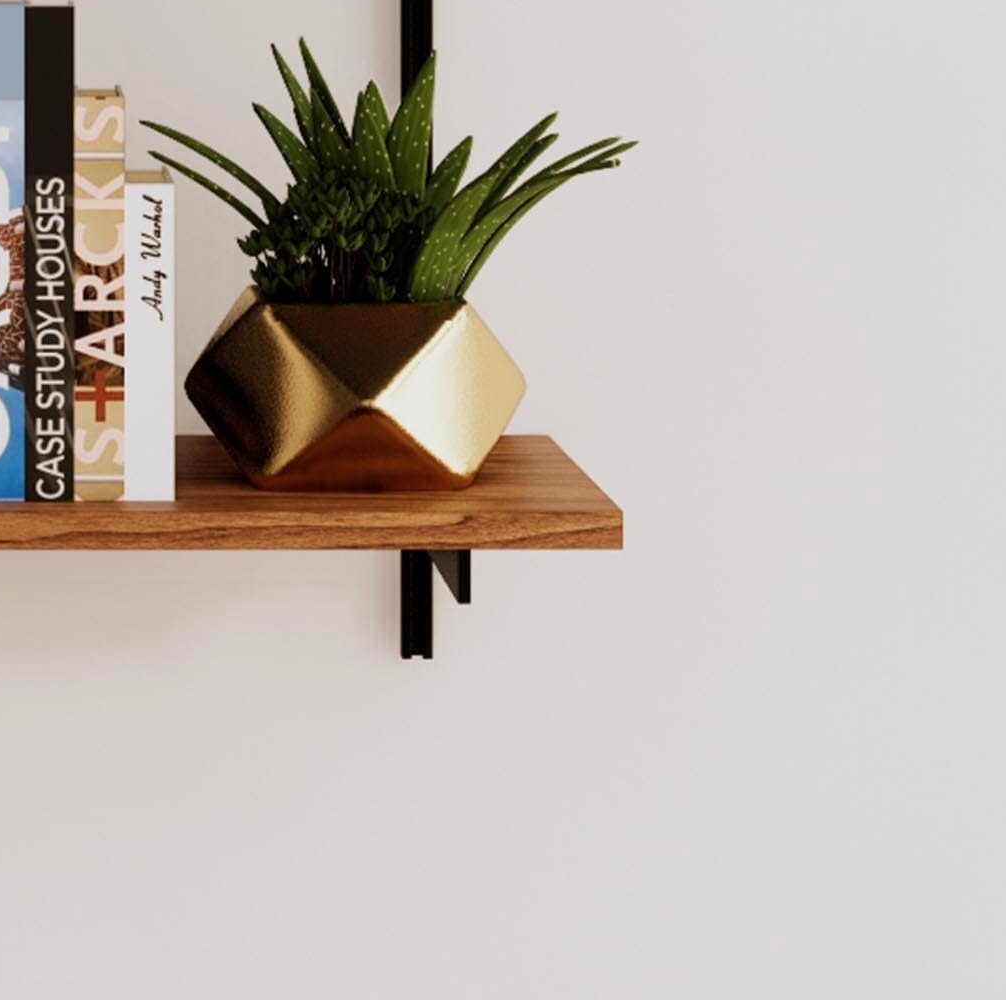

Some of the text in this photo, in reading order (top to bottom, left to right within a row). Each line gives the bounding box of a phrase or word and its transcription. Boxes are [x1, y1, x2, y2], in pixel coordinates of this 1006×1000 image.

[36, 177, 65, 499] CASE STUDY HOUSES
[140, 194, 168, 321] Andy Warhol
